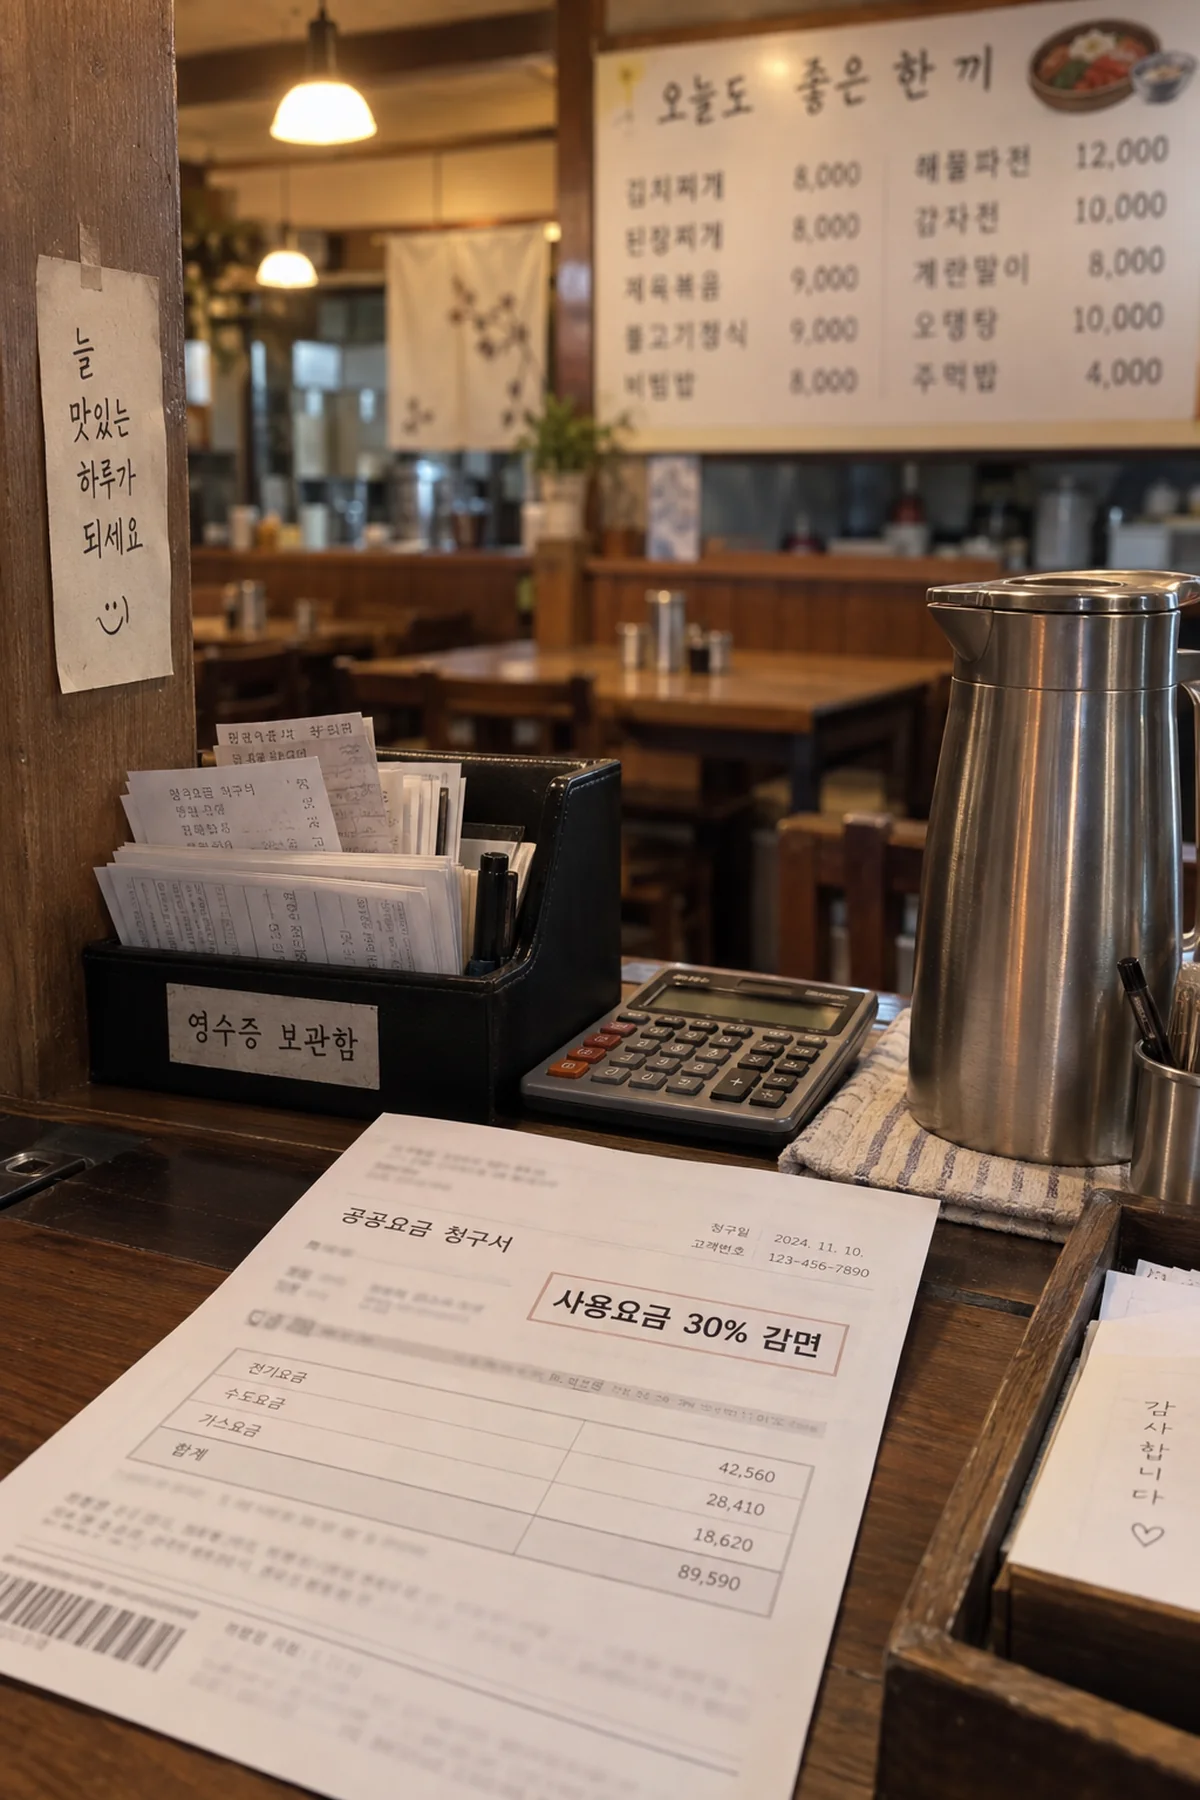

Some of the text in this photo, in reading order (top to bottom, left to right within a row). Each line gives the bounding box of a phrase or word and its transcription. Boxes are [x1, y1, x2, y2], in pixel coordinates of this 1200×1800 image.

[657, 43, 993, 126] 오늘도 좋은 한 끼
[915, 135, 1169, 184] 해물파전 12,000
[627, 160, 862, 210] 김치찌개 8,000
[625, 211, 861, 258] 된장찌개 8,000
[914, 190, 1168, 239] 감자전 10,000
[624, 264, 860, 304] 제육볶음 9,000
[913, 246, 1165, 289] 계란말이 8,000
[625, 315, 860, 355] 불고기정식 9,000
[1073, 301, 1165, 336] 10,000
[73, 328, 95, 380] 늘
[912, 357, 1164, 394] 주먹밥 4,000
[789, 366, 859, 398] 8,000
[69, 397, 131, 441] 맛있는
[76, 458, 137, 500] 하루가
[83, 517, 143, 559] 되세요
[188, 1010, 358, 1062] 영수증 보관함
[342, 1207, 513, 1253] 공공요금 청구서
[711, 1222, 864, 1258] 청구일 2024. 11. 10.
[768, 1252, 870, 1279] 123-456-7890
[553, 1288, 822, 1358] 사용요금 30% 감면
[249, 1362, 776, 1483] 전기요금 42,560
[225, 1387, 765, 1517] 수도요금 28,410
[1132, 1401, 1176, 1506] 감사합니다
[198, 1413, 754, 1553] 가스요금 18,620
[172, 1441, 741, 1592] 합계 89,590
